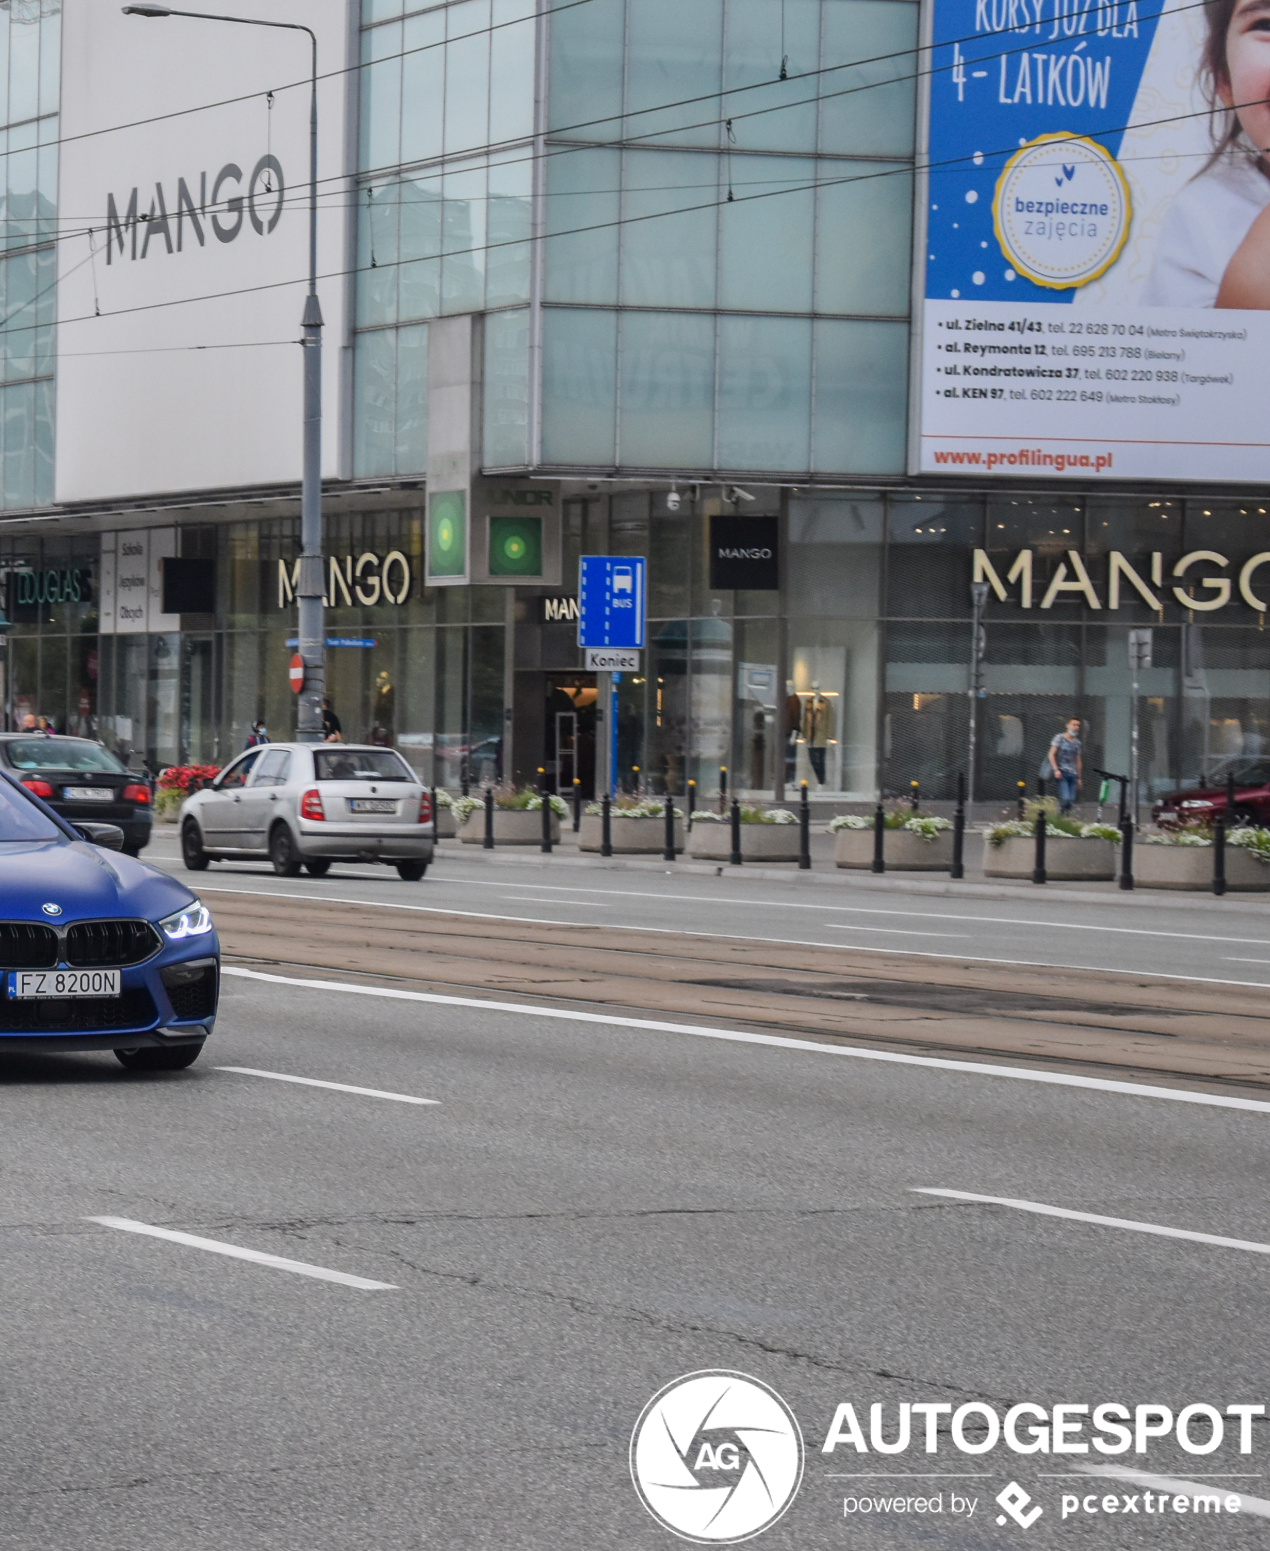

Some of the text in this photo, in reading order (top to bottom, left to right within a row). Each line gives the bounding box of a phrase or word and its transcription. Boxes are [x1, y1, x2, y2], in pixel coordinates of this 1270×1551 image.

[1097, 0, 1139, 38] DLA
[952, 43, 967, 101] 4
[998, 41, 1111, 109] LATKÓW
[106, 153, 285, 265] MANGO
[1015, 197, 1109, 217] bezpieczne
[1024, 218, 1098, 240] zajęcia
[946, 319, 962, 330] ul.
[965, 320, 1005, 332] Zielna
[1048, 323, 1066, 334] tel.
[1069, 323, 1083, 334] 22
[1086, 323, 1108, 335] 628
[1112, 324, 1126, 336] 70
[1129, 325, 1144, 336] 04
[945, 342, 962, 353] al.
[963, 343, 1032, 357] Reymonta
[1052, 345, 1069, 356] tel.
[1072, 345, 1096, 357] 695
[1099, 346, 1117, 358] 213
[944, 365, 960, 376] ul.
[963, 365, 1063, 378] Kondratowicza
[1084, 369, 1103, 380] tel.
[1106, 369, 1128, 381] 602
[1131, 370, 1153, 382] 220
[1156, 371, 1178, 382] 938
[944, 387, 959, 398] al.
[962, 388, 988, 399] KEN
[1009, 389, 1026, 400] tel.
[1031, 389, 1052, 401] 602
[1056, 390, 1077, 401] 222
[1080, 390, 1103, 402] 649
[934, 449, 1113, 472] www.profilingua.pl
[718, 548, 772, 559] MANGO
[17, 568, 80, 604] DOUGLAS
[278, 551, 411, 608] MNGO
[612, 598, 633, 609] BUS
[590, 652, 636, 669] Koniec
[21, 972, 116, 994] FZ 8200N
